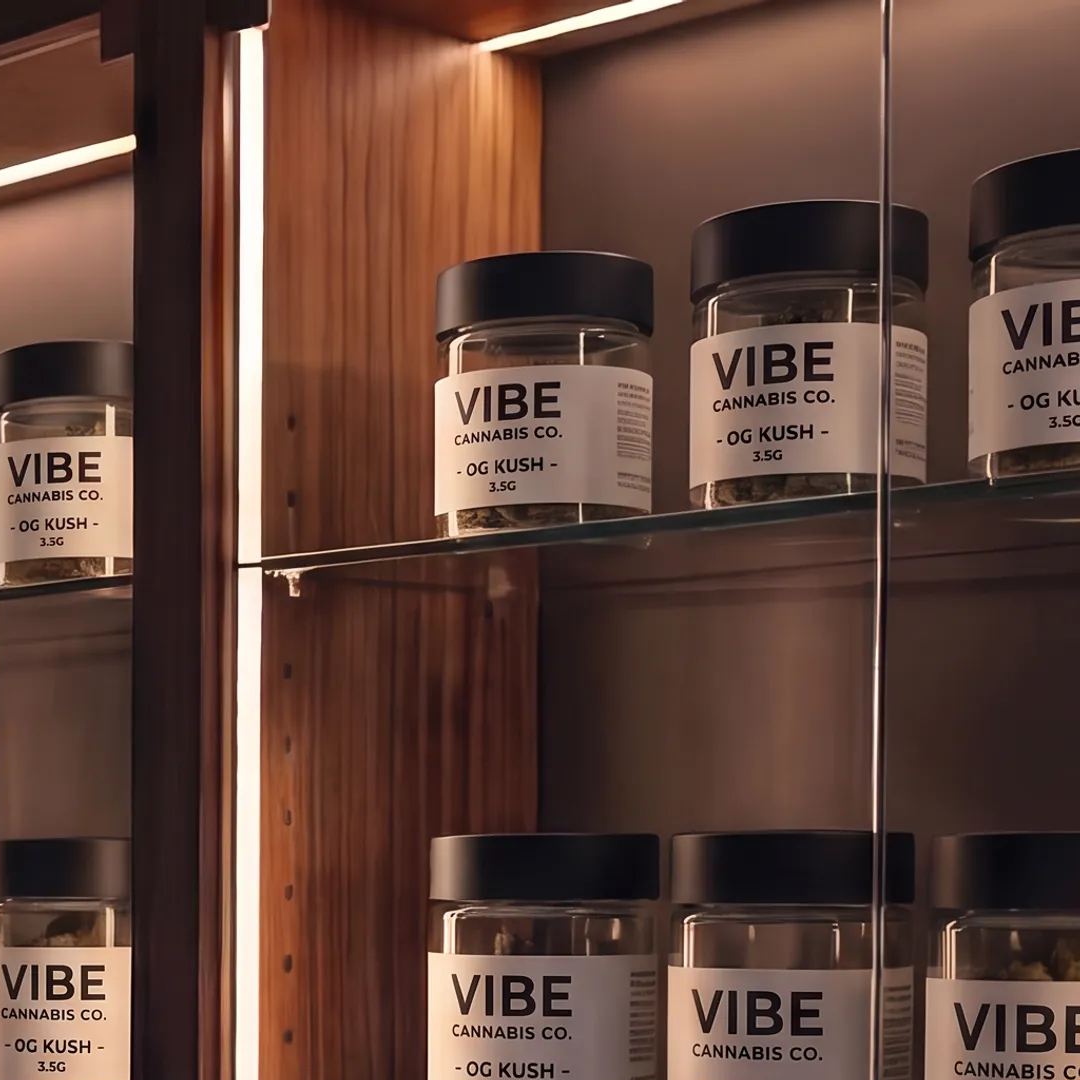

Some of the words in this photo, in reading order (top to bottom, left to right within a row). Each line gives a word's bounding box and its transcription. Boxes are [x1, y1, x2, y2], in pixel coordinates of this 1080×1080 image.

[1001, 299, 1080, 351] VI
[712, 341, 834, 391] VIBE
[1002, 351, 1080, 375] CANNAB
[455, 381, 561, 425] VIBE
[713, 390, 797, 413] CANNABIS
[803, 390, 835, 404] CO.
[1020, 392, 1050, 411] OG
[1057, 389, 1080, 407] KU
[454, 426, 529, 446] CANNABIS
[533, 426, 563, 439] CO.
[727, 428, 752, 446] OG
[759, 424, 814, 443] KUSH
[752, 447, 783, 463] 3.5G
[7, 451, 101, 488] VIBE
[466, 461, 489, 477] OG
[494, 456, 544, 474] KUSH
[489, 480, 516, 493] 3.5G
[7, 490, 74, 505] CANNABIS
[78, 490, 103, 501] CO.
[17, 519, 40, 533] OG
[45, 517, 87, 531] KUSH
[39, 536, 64, 547] 3.5G
[1, 963, 106, 1001] VIBE
[451, 973, 573, 1017] VIBE
[0, 1007, 75, 1021] CANNABIS
[80, 1009, 107, 1021] CO.
[691, 989, 823, 1036] VIBE
[452, 1024, 536, 1040] CANNABIS
[541, 1026, 572, 1040] CO.
[14, 1038, 38, 1053] OG
[43, 1039, 91, 1054] KUSH
[692, 1043, 783, 1061] CANNABIS
[789, 1046, 823, 1061] CO.
[37, 1061, 66, 1073] 3.5G
[466, 1060, 492, 1078] OG
[498, 1062, 554, 1079] KUSH
[954, 1060, 1055, 1080] CANNABIS
